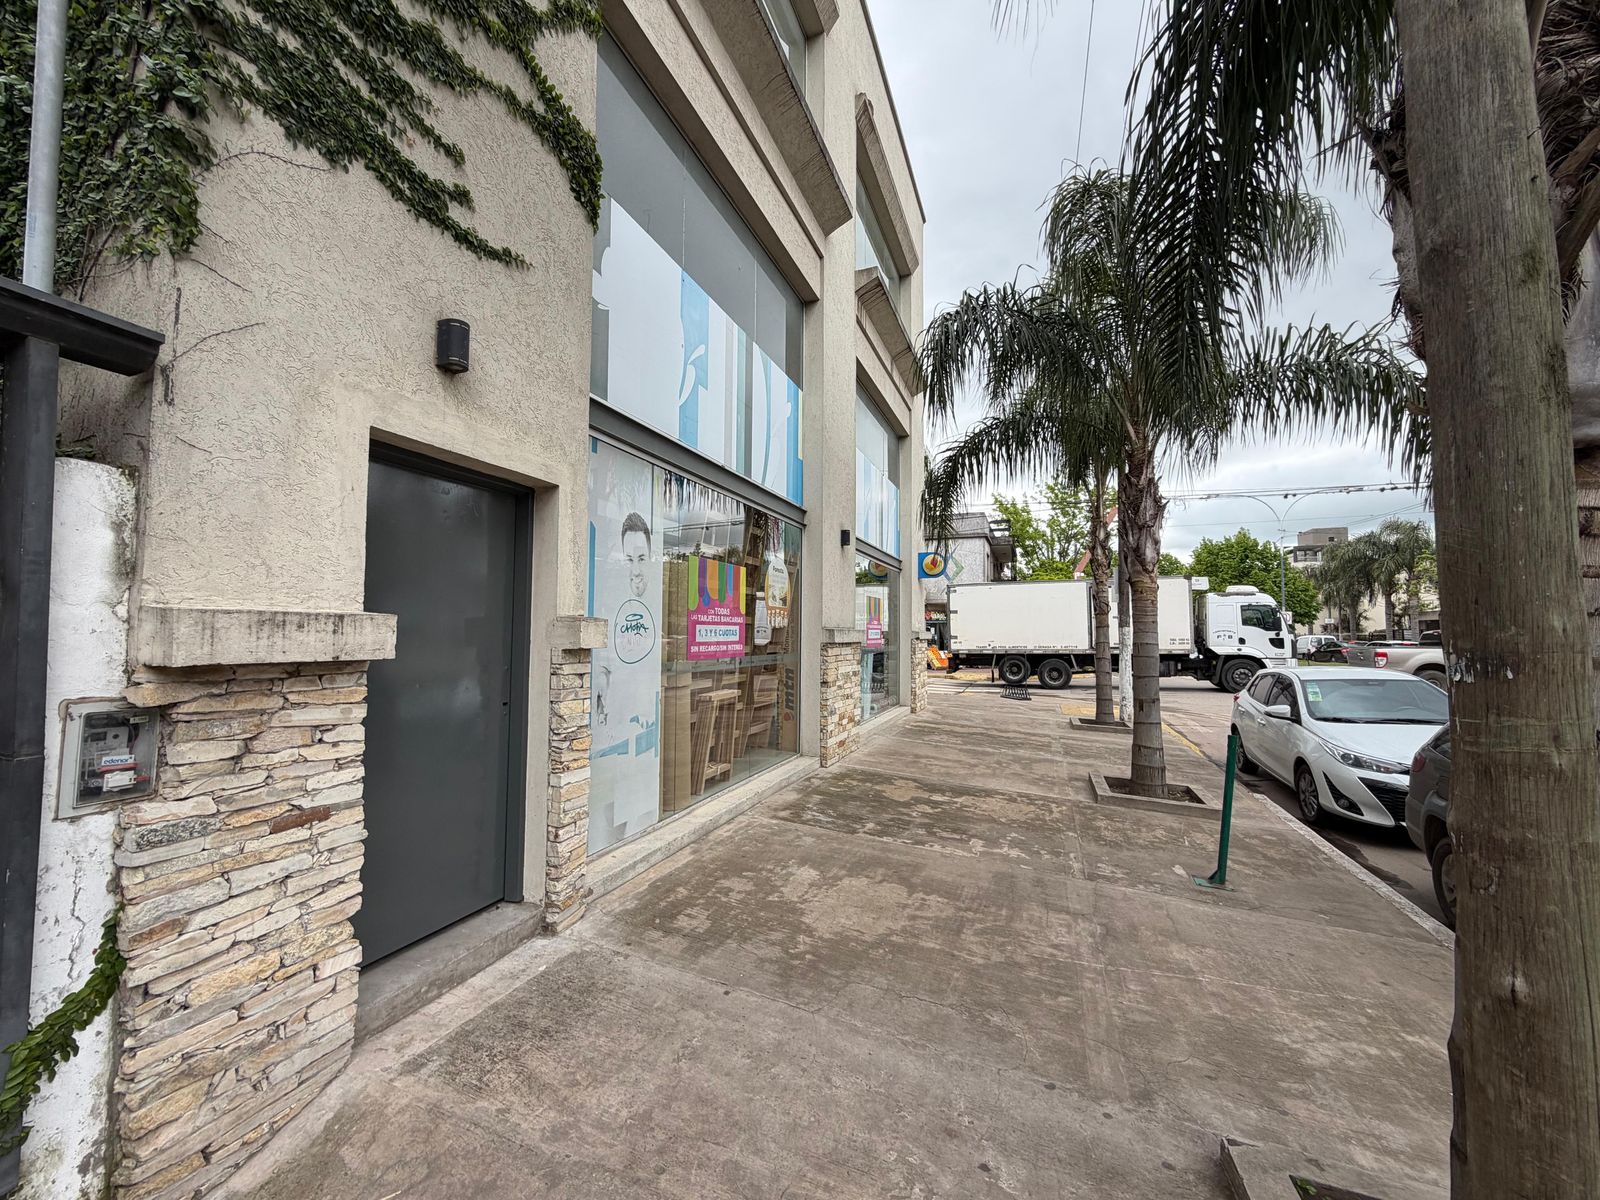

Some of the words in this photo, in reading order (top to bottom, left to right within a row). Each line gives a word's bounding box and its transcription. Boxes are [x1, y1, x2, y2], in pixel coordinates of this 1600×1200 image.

[714, 607, 730, 615] TODAS
[698, 614, 720, 622] TARJETAS
[720, 615, 743, 623] BANCARIAS
[704, 629, 708, 637] 3
[709, 629, 713, 637] Y
[718, 629, 738, 637] CUOTAS
[690, 645, 699, 653] SIN
